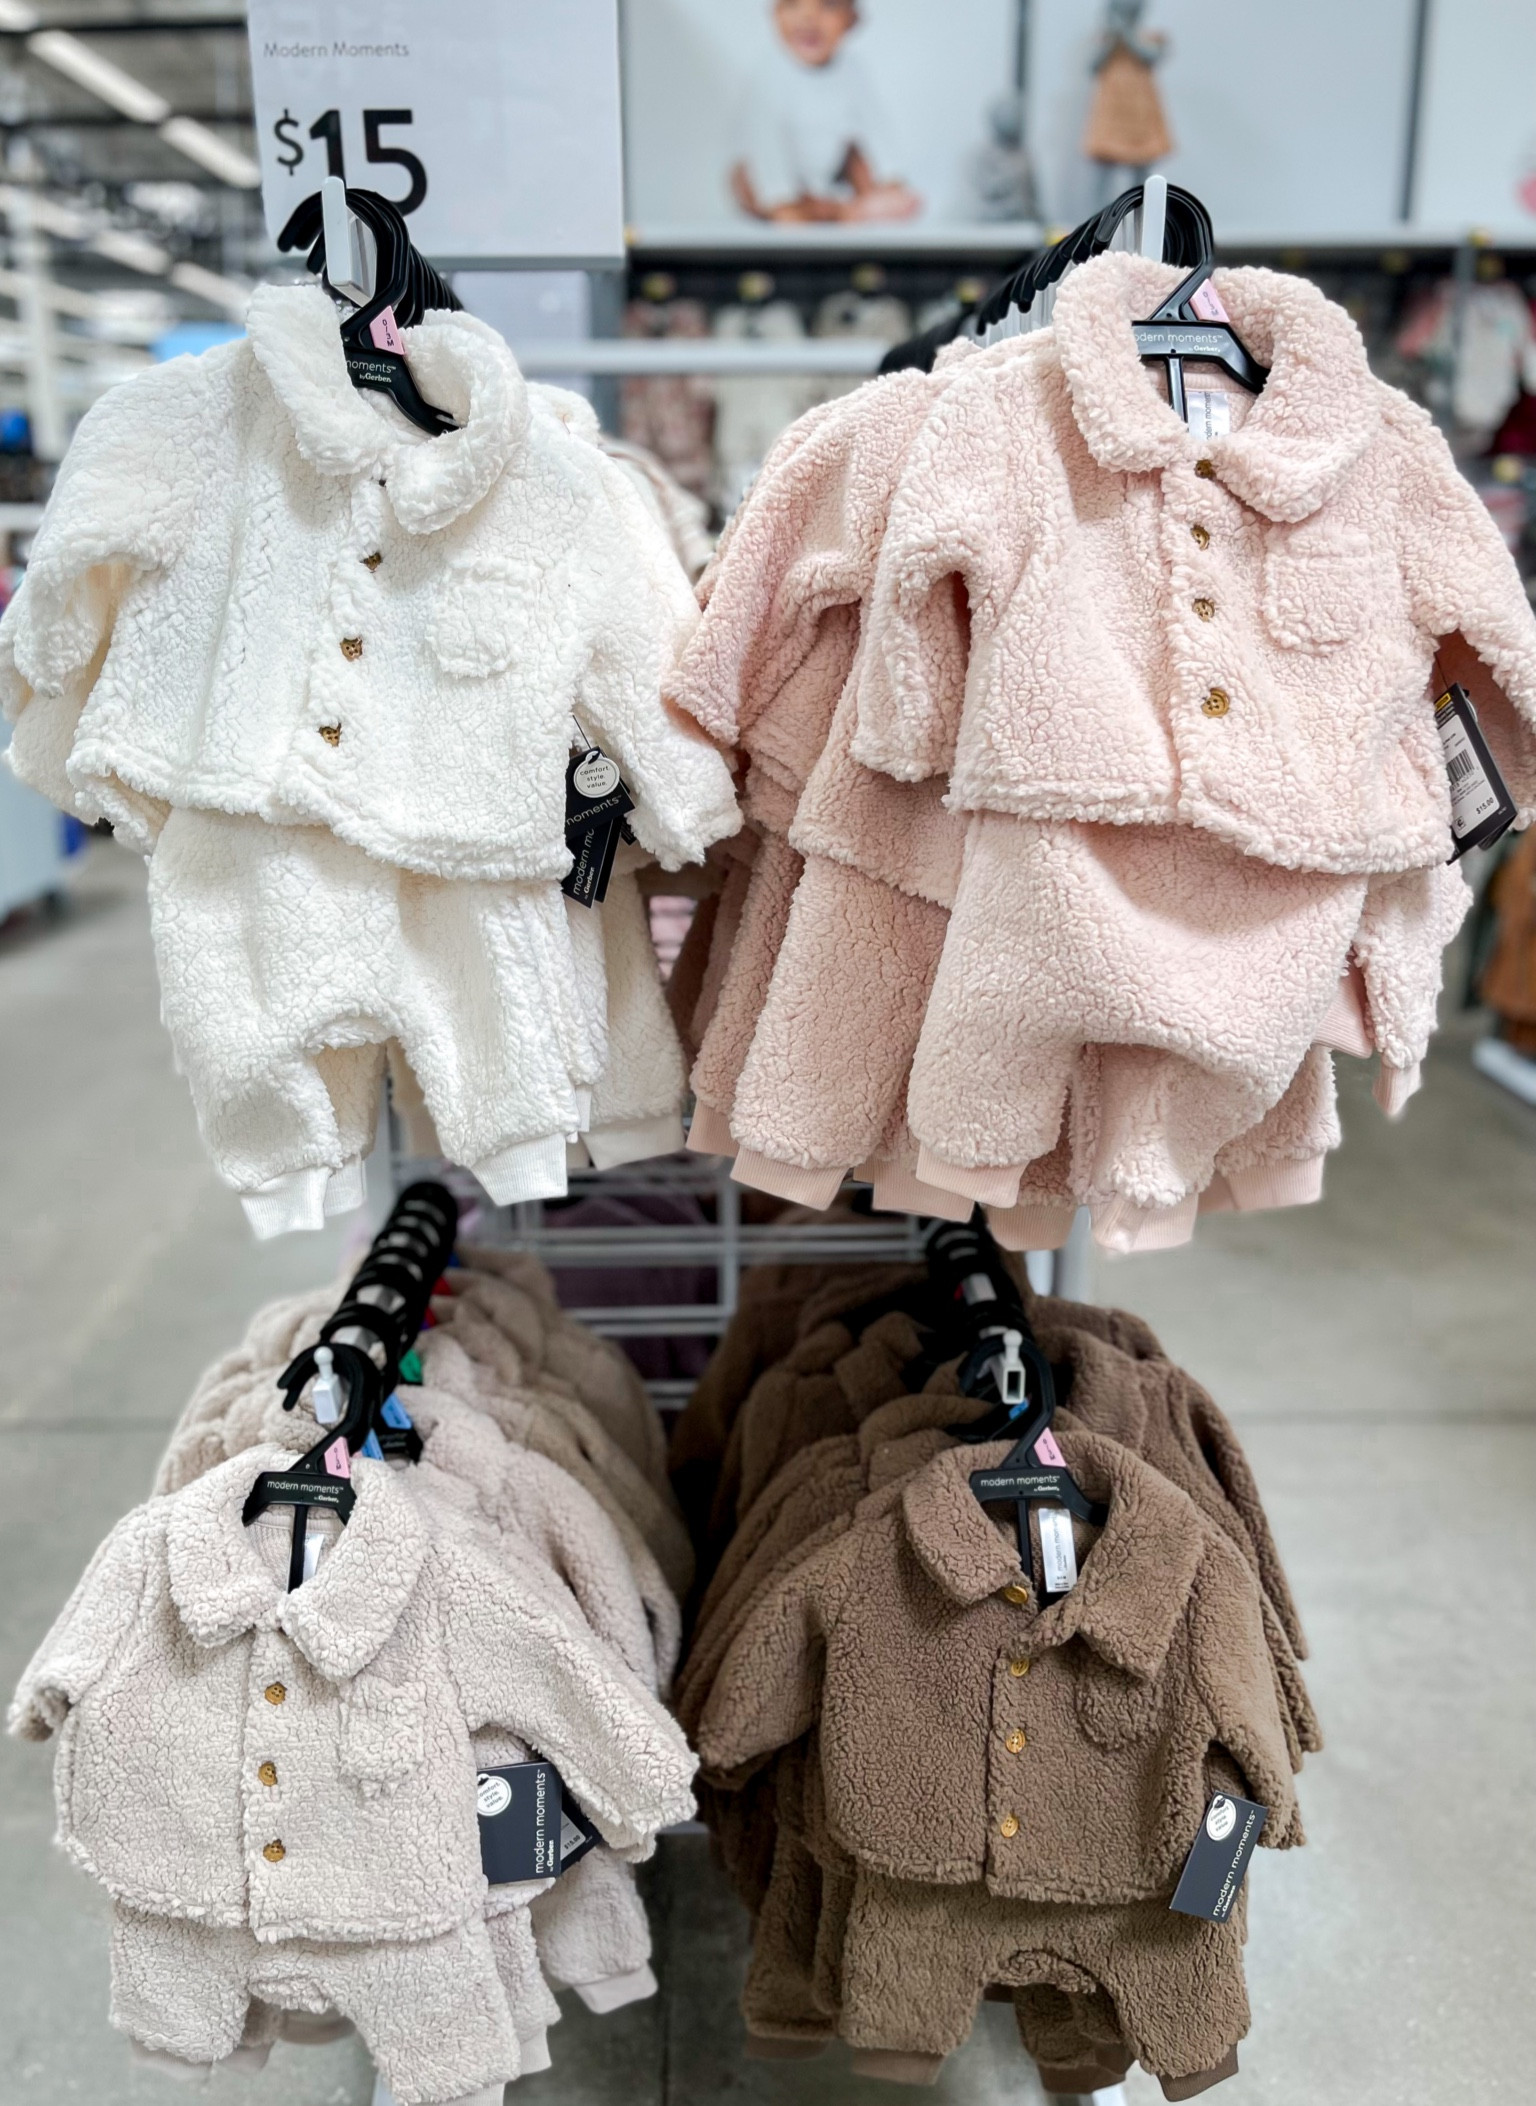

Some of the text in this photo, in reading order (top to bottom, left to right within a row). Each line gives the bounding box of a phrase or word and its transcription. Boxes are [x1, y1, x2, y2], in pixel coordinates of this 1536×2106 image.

[263, 41, 410, 58] Modern Moments
[274, 109, 428, 217] $15
[1135, 332, 1218, 344] odern moments
[573, 849, 590, 896] modern
[267, 1481, 339, 1494] modern moments
[981, 1475, 1058, 1487] modern moments
[534, 1772, 546, 1873] modern moments
[1213, 1814, 1256, 1917] modern moments
